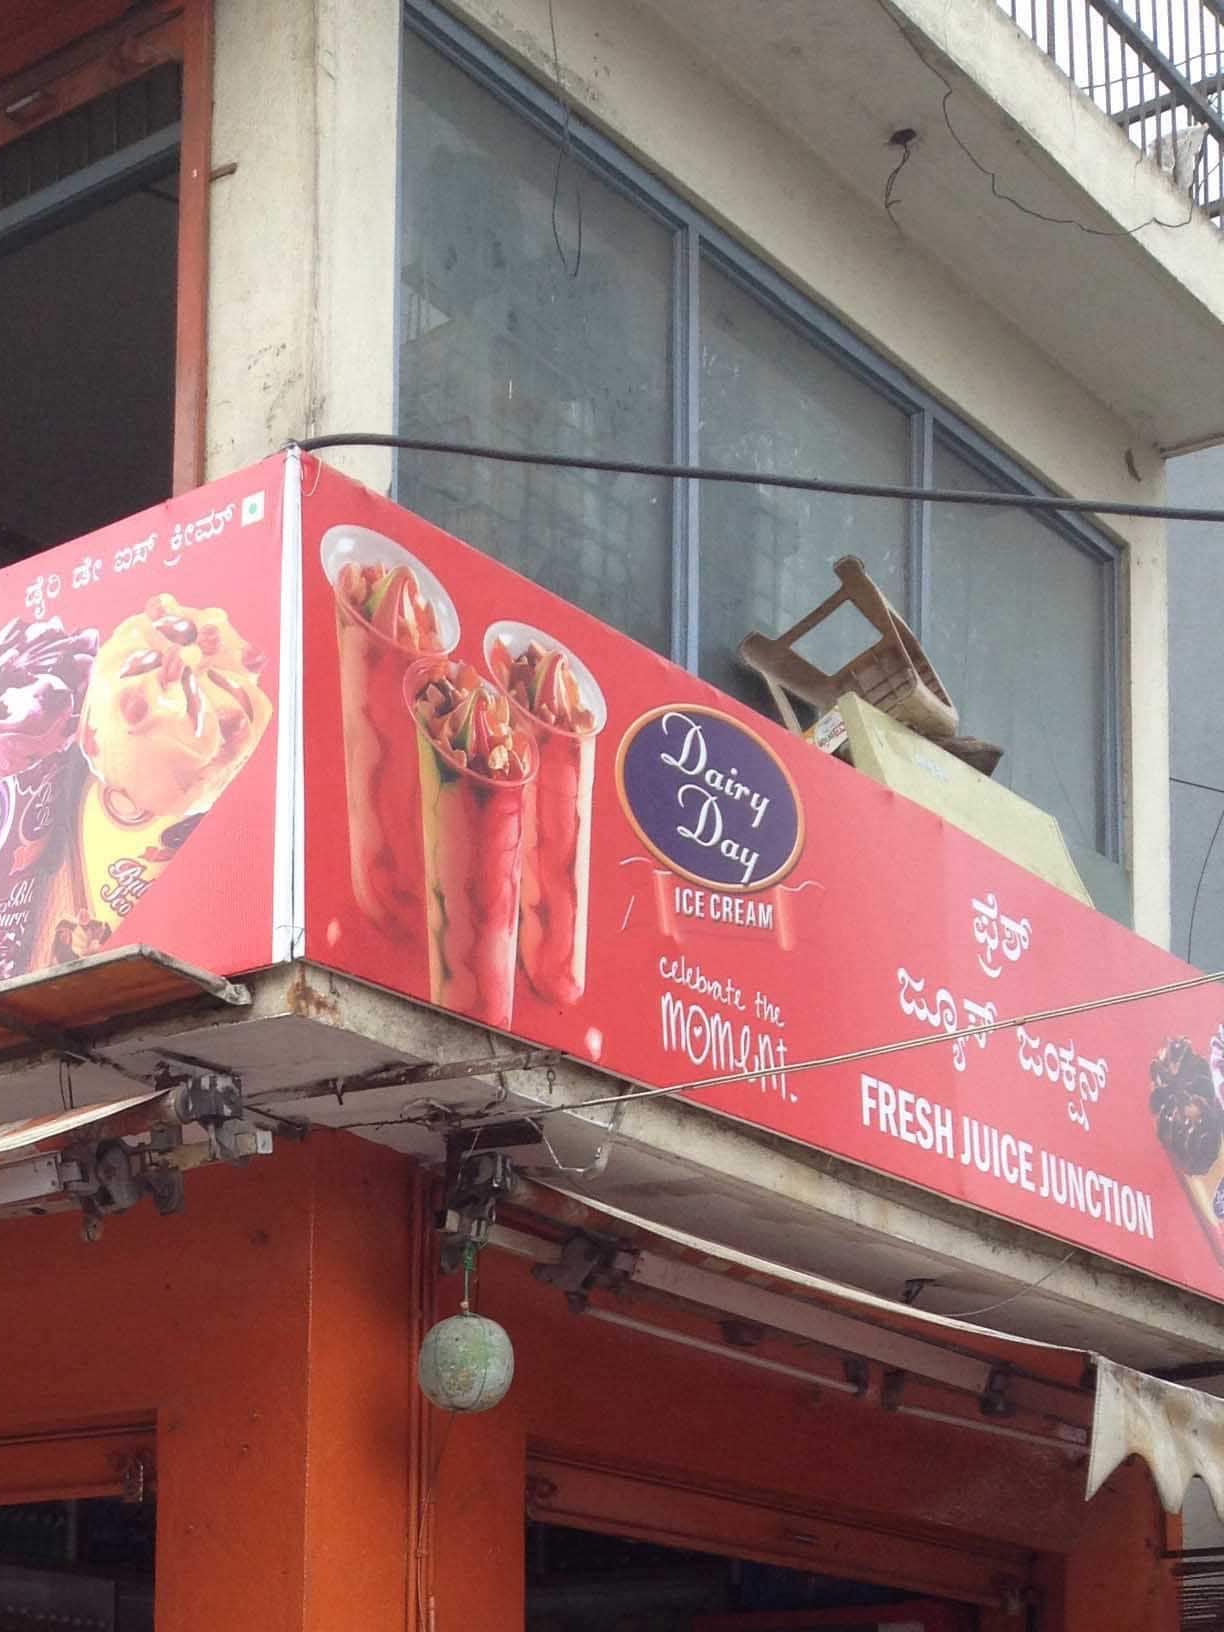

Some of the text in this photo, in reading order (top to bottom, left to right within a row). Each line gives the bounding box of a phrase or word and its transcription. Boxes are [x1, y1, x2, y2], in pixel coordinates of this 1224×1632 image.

[660, 712, 770, 827] Dairy
[677, 783, 760, 884] Day
[675, 887, 775, 930] ICE CREAM
[660, 955, 785, 1028] celebrate the
[861, 1073, 954, 1159] FRESH
[962, 1116, 1036, 1192] JUICE
[1040, 1151, 1154, 1240] JUNCTION
